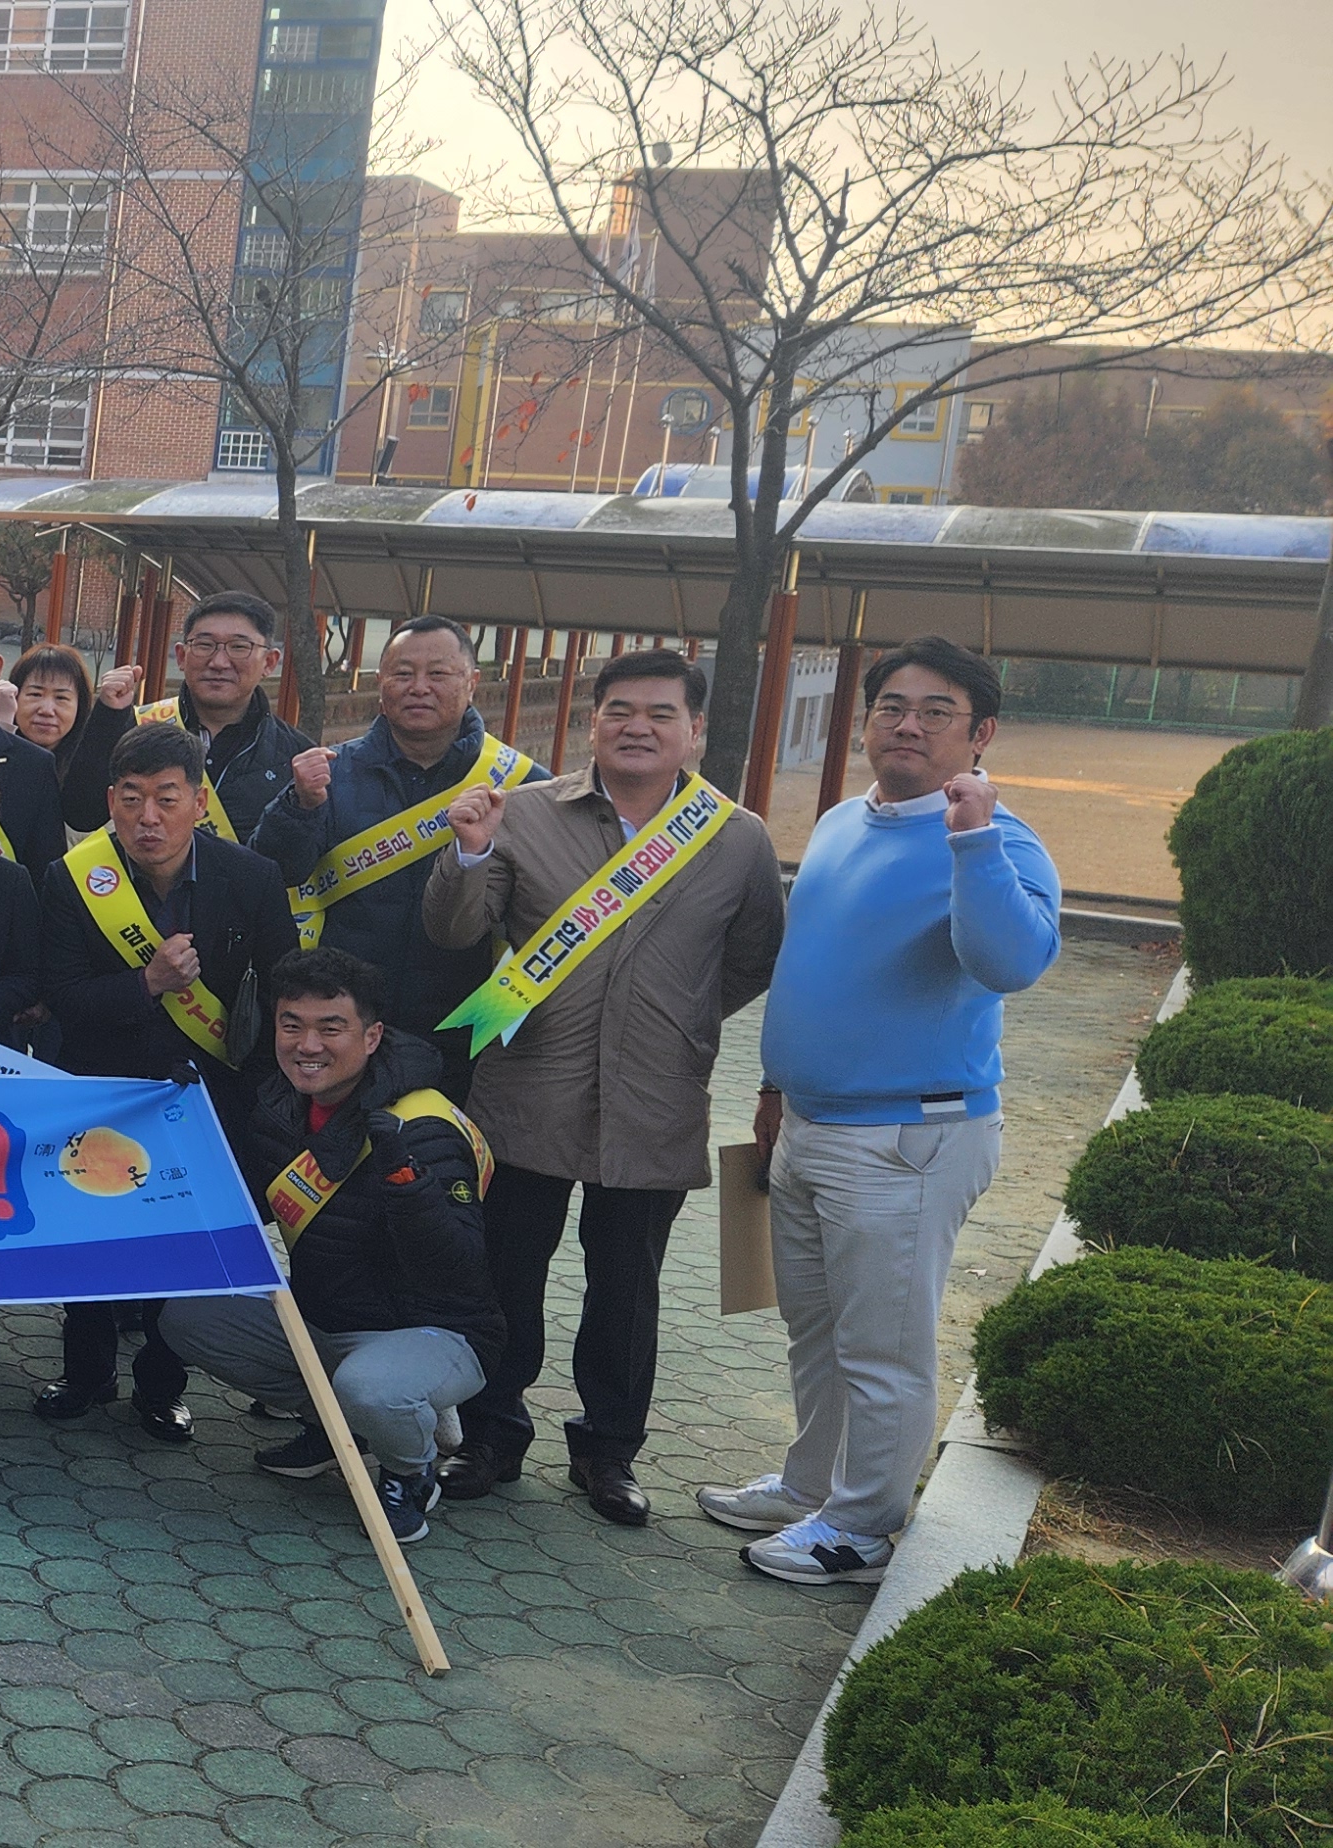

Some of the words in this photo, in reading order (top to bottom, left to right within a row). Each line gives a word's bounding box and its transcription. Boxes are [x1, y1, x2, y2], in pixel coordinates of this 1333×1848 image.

[344, 828, 414, 878] 담배연기
[609, 833, 678, 897] 금연을
[521, 887, 624, 984] 약속합니다
[64, 1130, 87, 1158] 청
[127, 1165, 148, 1189] 온
[286, 1170, 321, 1204] SMOKING
